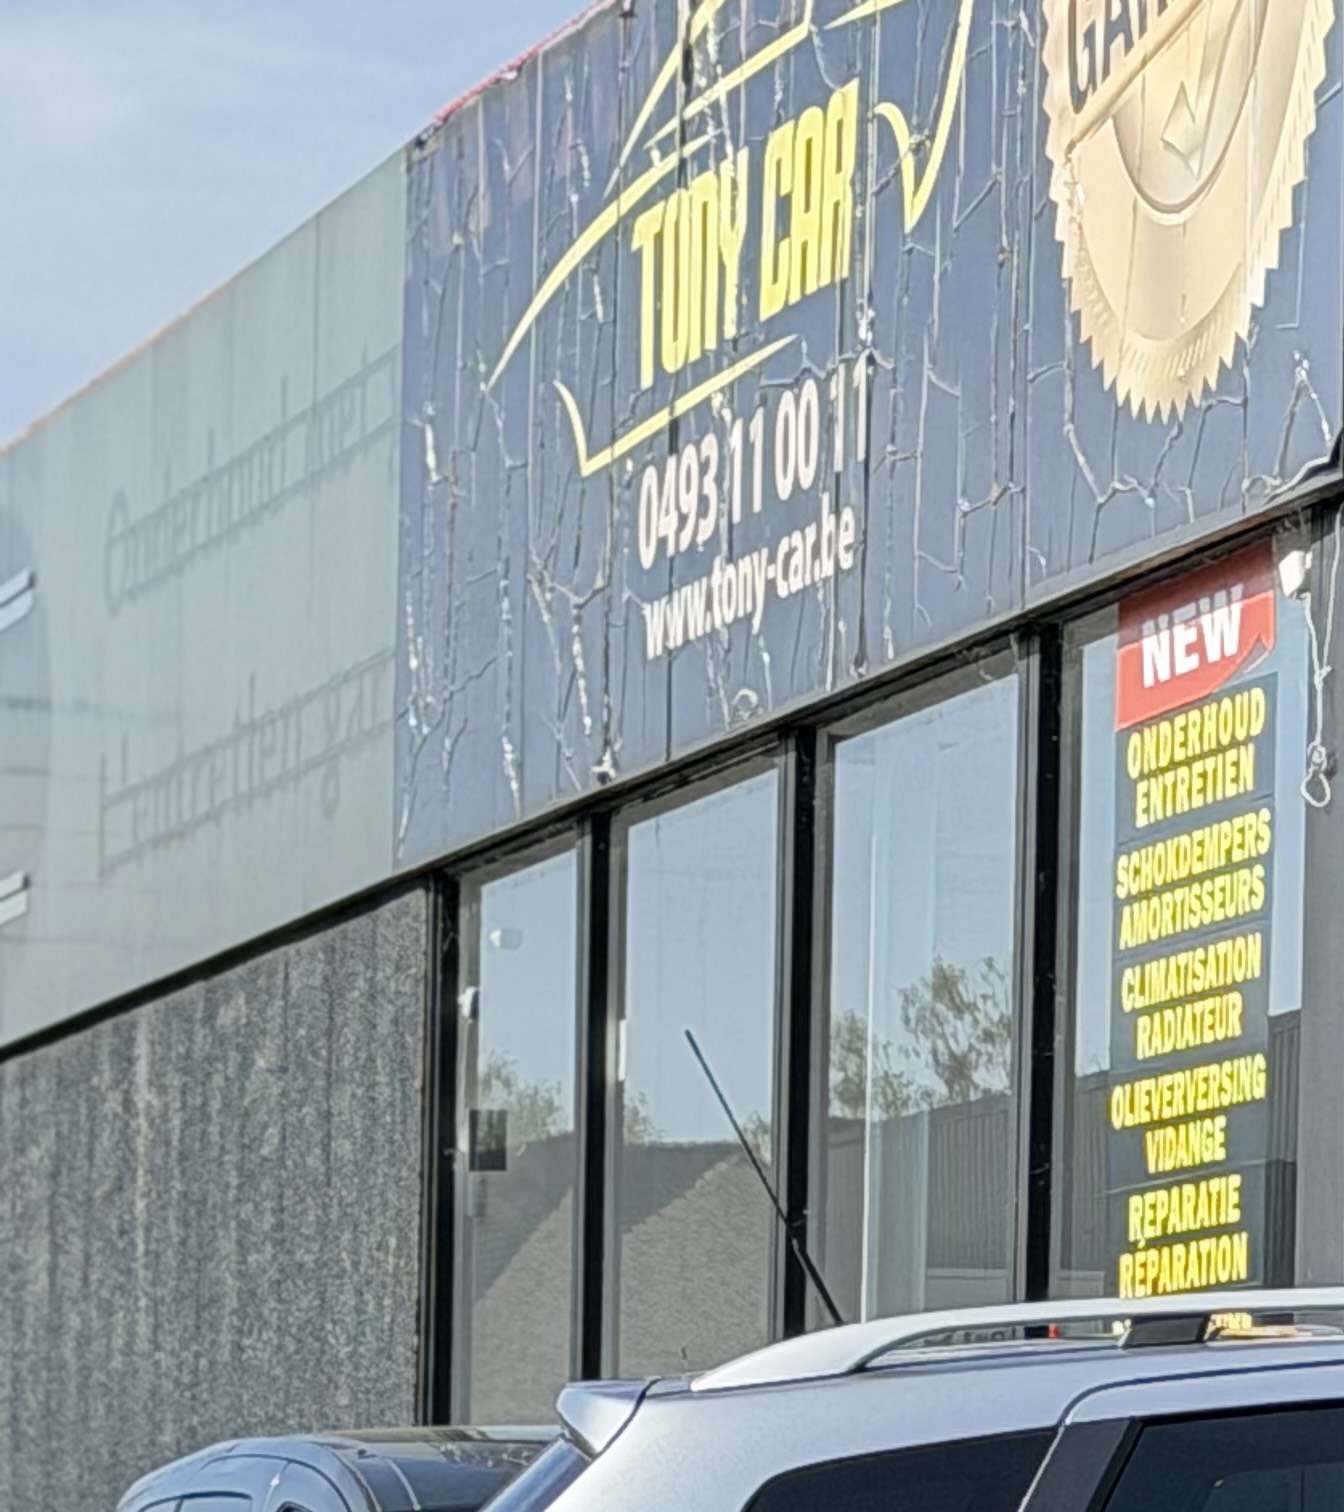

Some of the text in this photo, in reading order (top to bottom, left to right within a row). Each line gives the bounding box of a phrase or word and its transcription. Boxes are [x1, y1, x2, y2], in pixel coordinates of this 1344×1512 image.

[1067, 0, 1170, 115] GA
[631, 76, 860, 391] TONY CAR
[638, 352, 868, 570] 0493 11 00 11
[641, 492, 856, 661] www.tony-car.be
[1141, 583, 1245, 689] NEW
[1126, 686, 1266, 780] ONDERHOUD
[1135, 742, 1256, 829] ENTRETIEN
[1115, 807, 1272, 900] SCHOKDEMPERS
[1118, 863, 1266, 951] AMORTISSEURS
[1120, 931, 1263, 1014] CLIMATISATION
[1135, 990, 1244, 1061] RADIATEUR
[1110, 1052, 1267, 1131] OLIEVERVERSING
[1145, 1114, 1228, 1175] VIDANGE
[1128, 1173, 1243, 1243] REPARATIE
[1118, 1231, 1249, 1299] RÉPARATION
